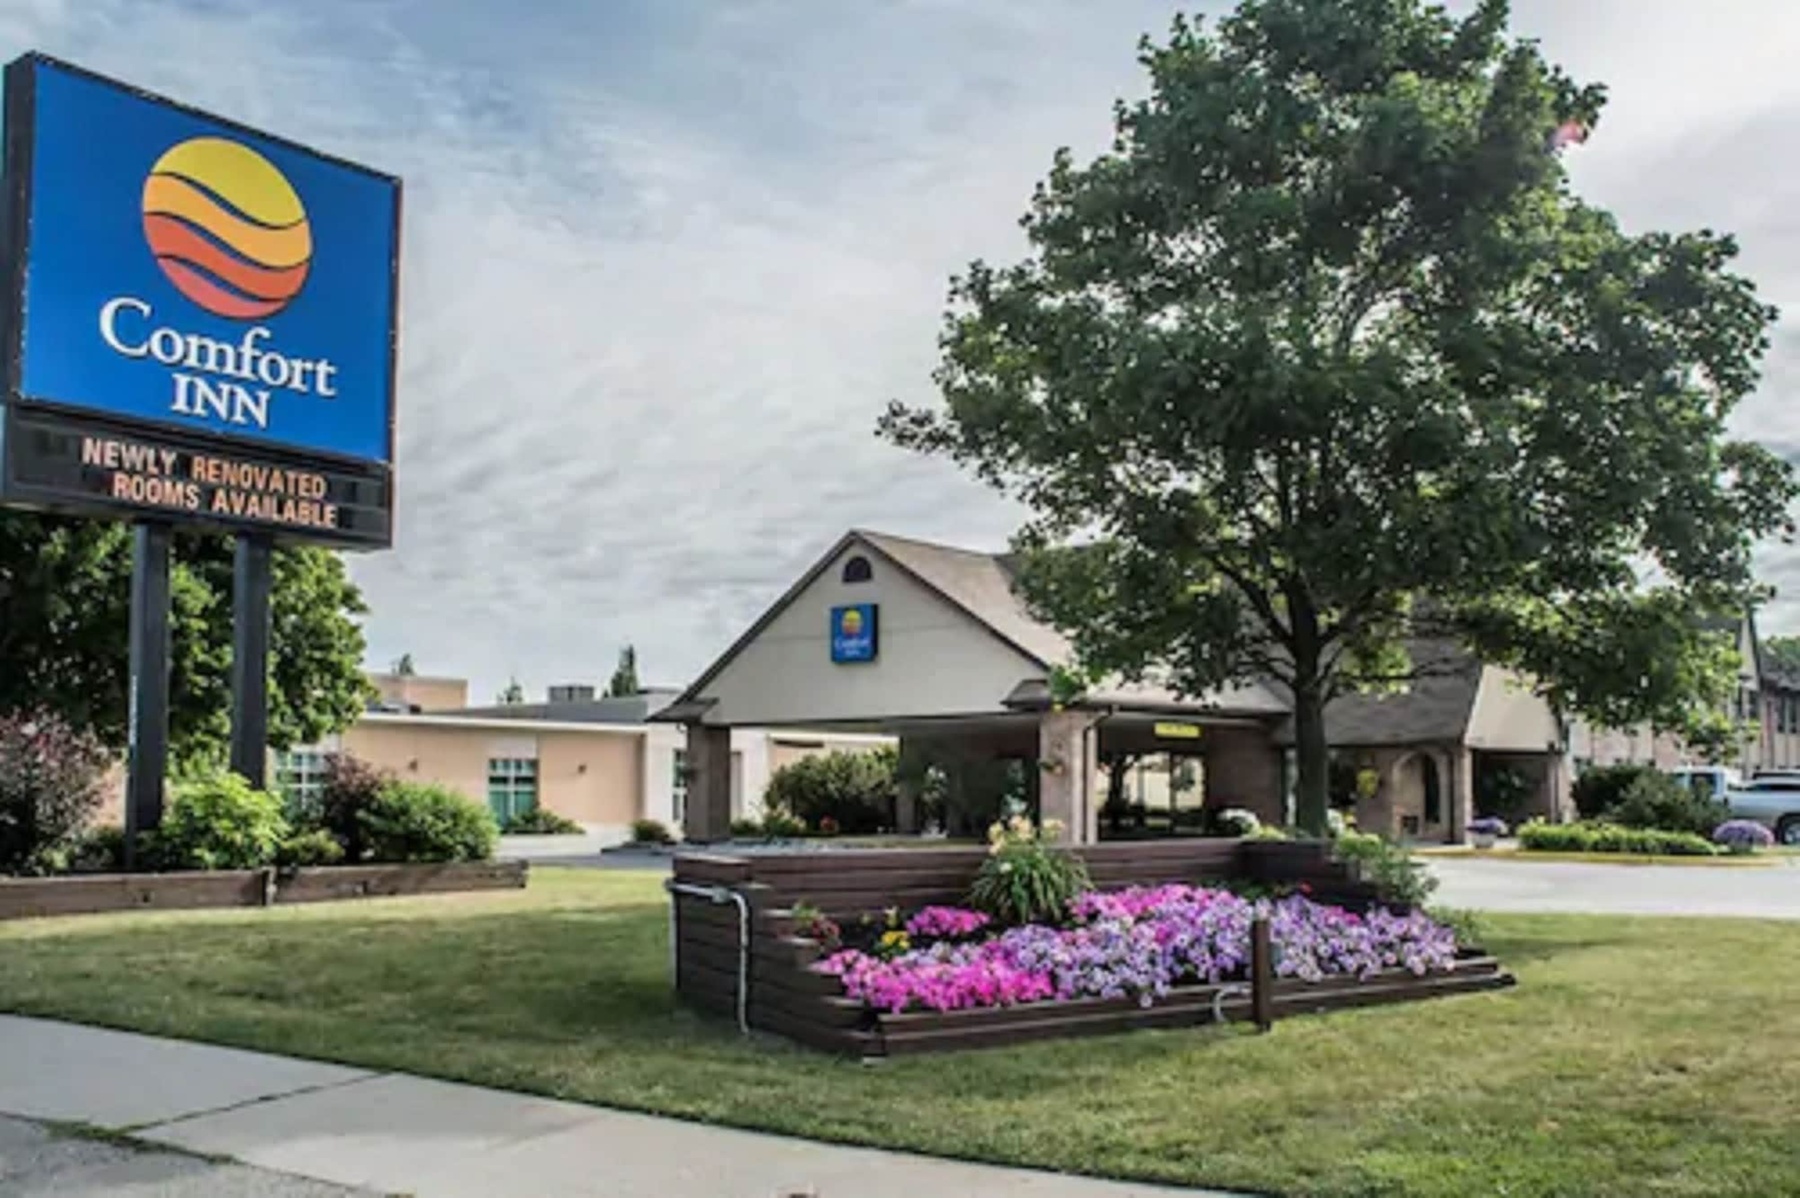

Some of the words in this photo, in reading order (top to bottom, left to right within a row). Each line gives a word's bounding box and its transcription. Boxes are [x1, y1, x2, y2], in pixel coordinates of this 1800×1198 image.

[100, 297, 336, 396] Comfort
[171, 372, 269, 427] INN
[82, 438, 177, 474] NEWLY
[192, 456, 326, 499] RENOVATED
[114, 473, 200, 509] ROOMS
[212, 489, 337, 528] AVAILABLE
